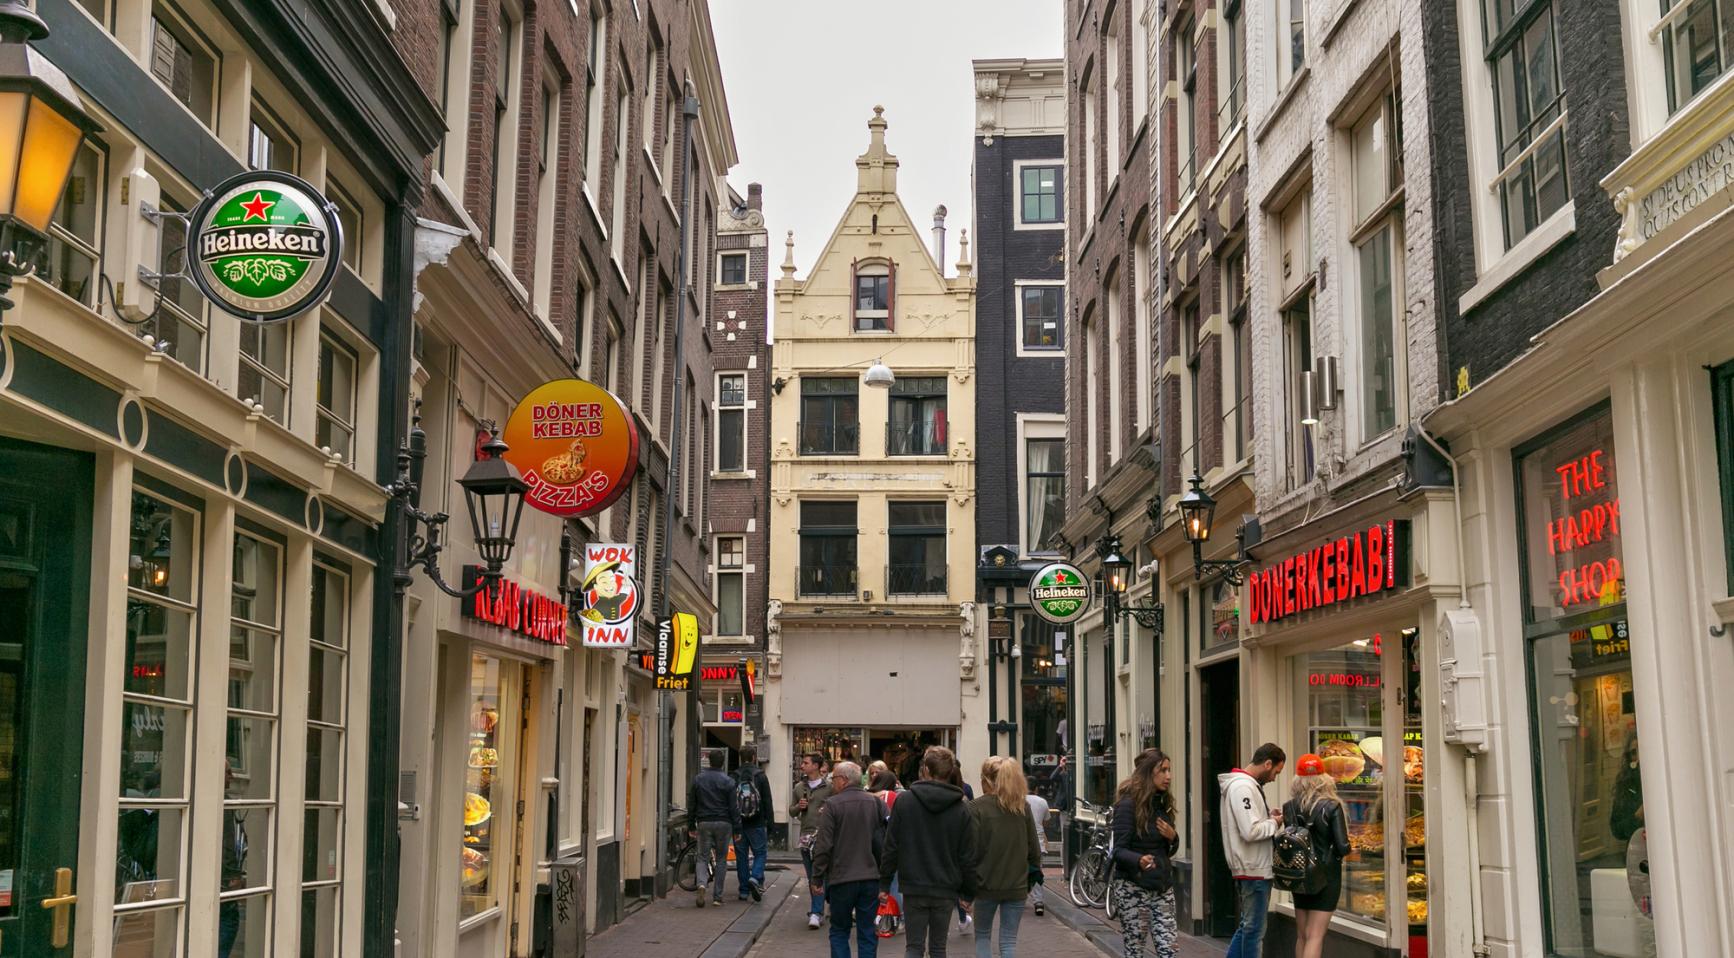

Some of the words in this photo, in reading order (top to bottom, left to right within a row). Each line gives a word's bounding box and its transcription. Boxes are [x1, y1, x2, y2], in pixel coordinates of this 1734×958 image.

[1696, 143, 1725, 178] PRO
[1681, 162, 1734, 213] CONTR
[202, 228, 320, 256] Heineken
[532, 401, 603, 421] DÖNER
[532, 420, 603, 439] KEBAB
[522, 469, 609, 507] PIZZA'S
[1556, 450, 1605, 500] THE
[1547, 498, 1621, 556] HAPPY
[588, 547, 634, 564] WOK
[1250, 523, 1383, 625] DONERKEBAB
[1558, 557, 1622, 608] SHOP
[1035, 587, 1087, 600] Heineken
[522, 588, 568, 647] CORNER
[587, 627, 630, 644] INN
[658, 620, 671, 675] Vlaamse
[657, 676, 689, 689] Friet
[1242, 797, 1252, 810] 3
